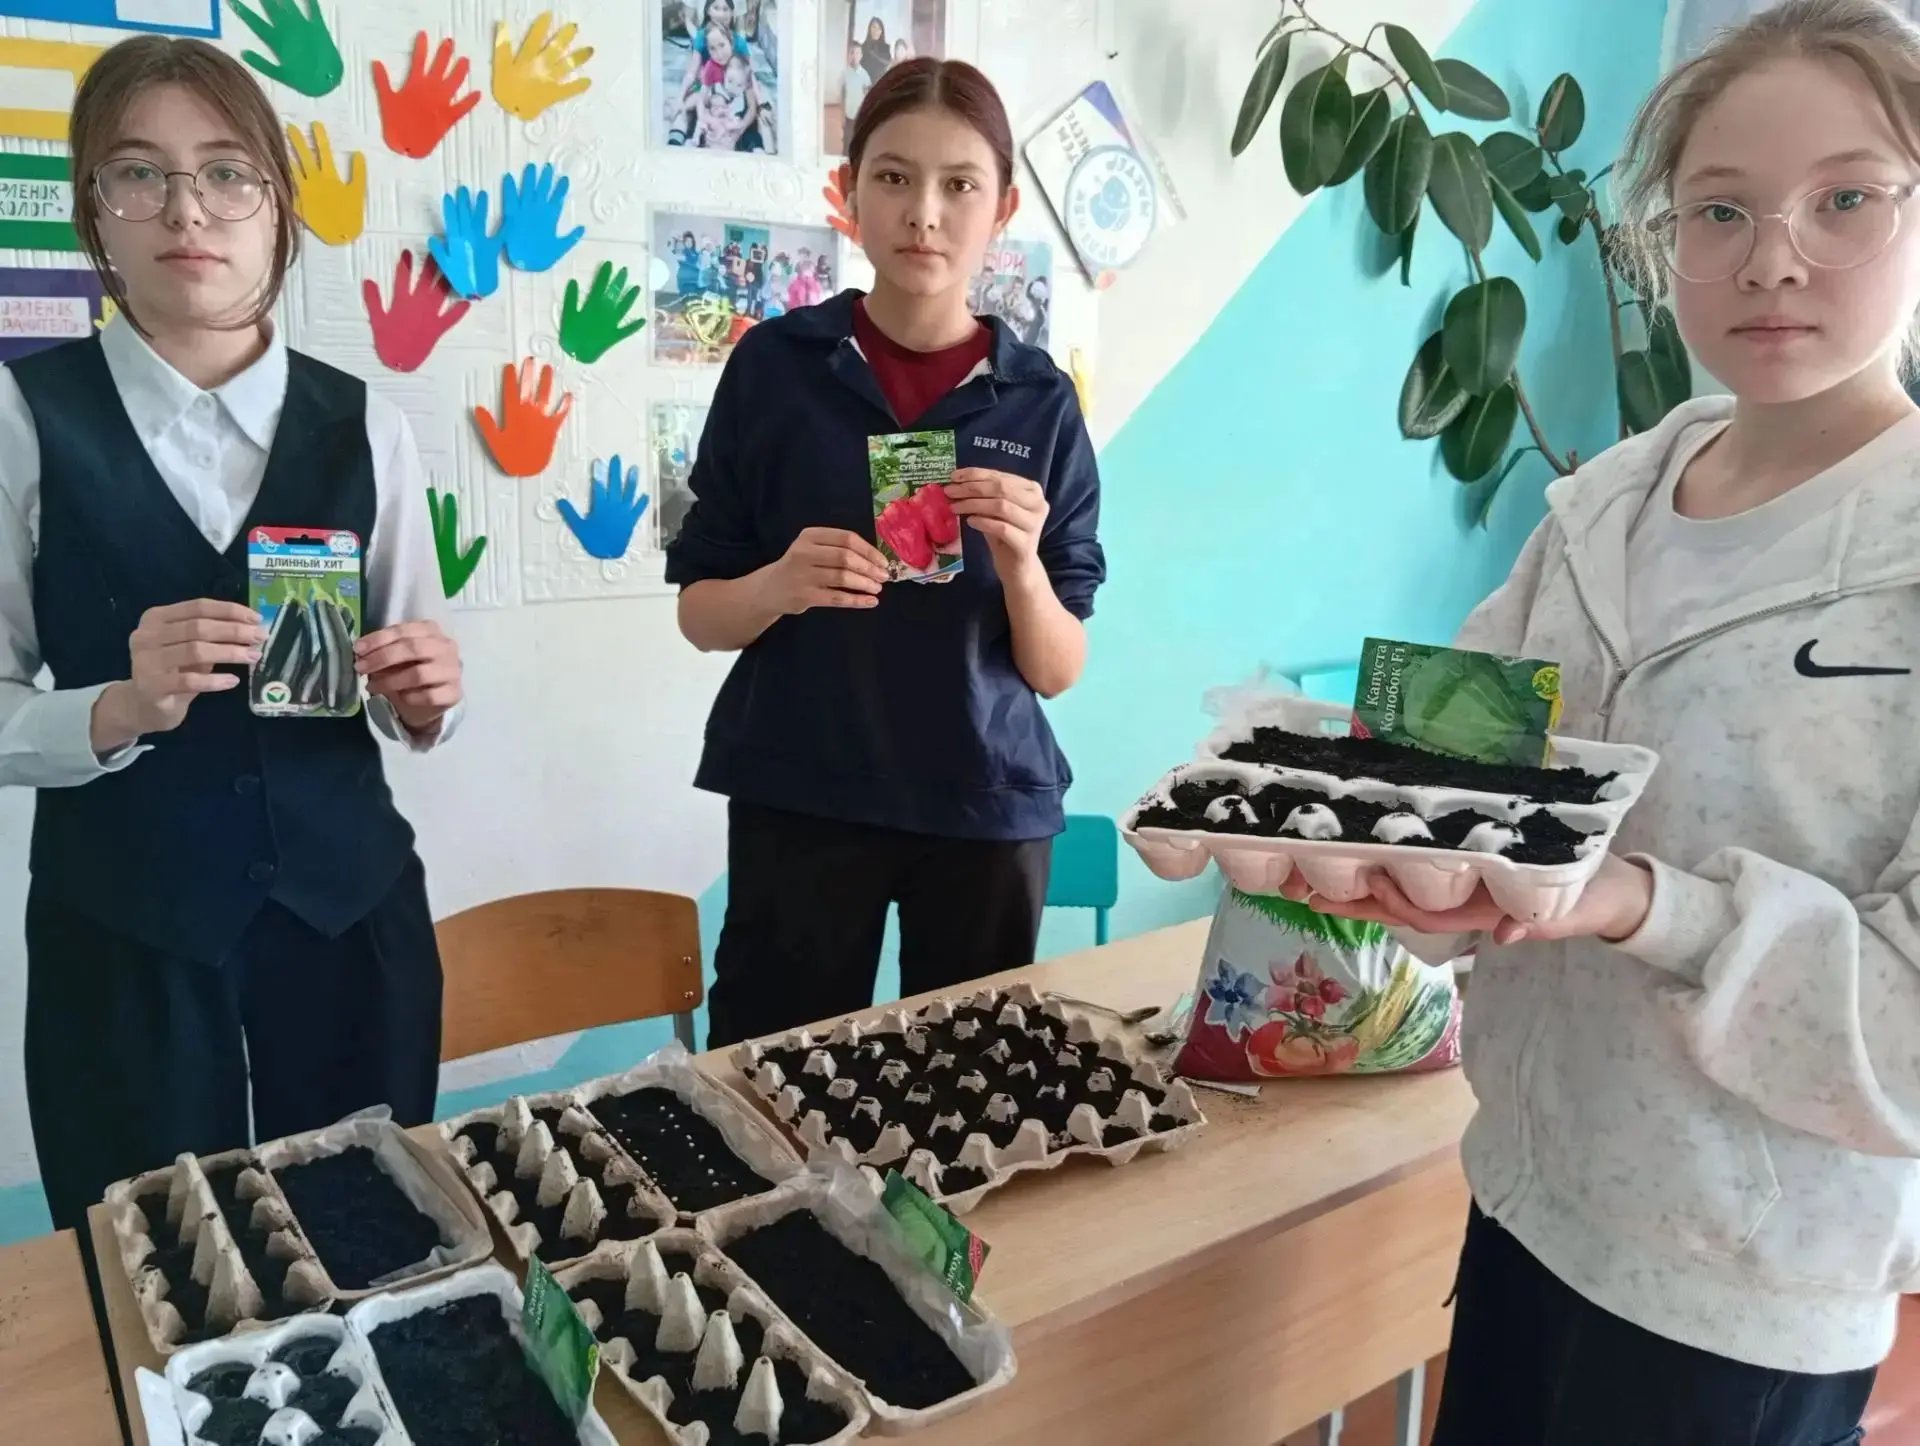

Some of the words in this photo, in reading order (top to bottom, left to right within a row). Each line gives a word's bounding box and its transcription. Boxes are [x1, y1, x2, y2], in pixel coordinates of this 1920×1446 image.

[973, 436, 999, 449] NEW
[1000, 440, 1032, 459] YORK
[265, 557, 321, 569] ДЛИННЫЙ
[323, 559, 345, 569] ХИТ
[1366, 644, 1388, 706] Капуста
[1379, 669, 1401, 733] Колобок
[1391, 647, 1406, 664] F1
